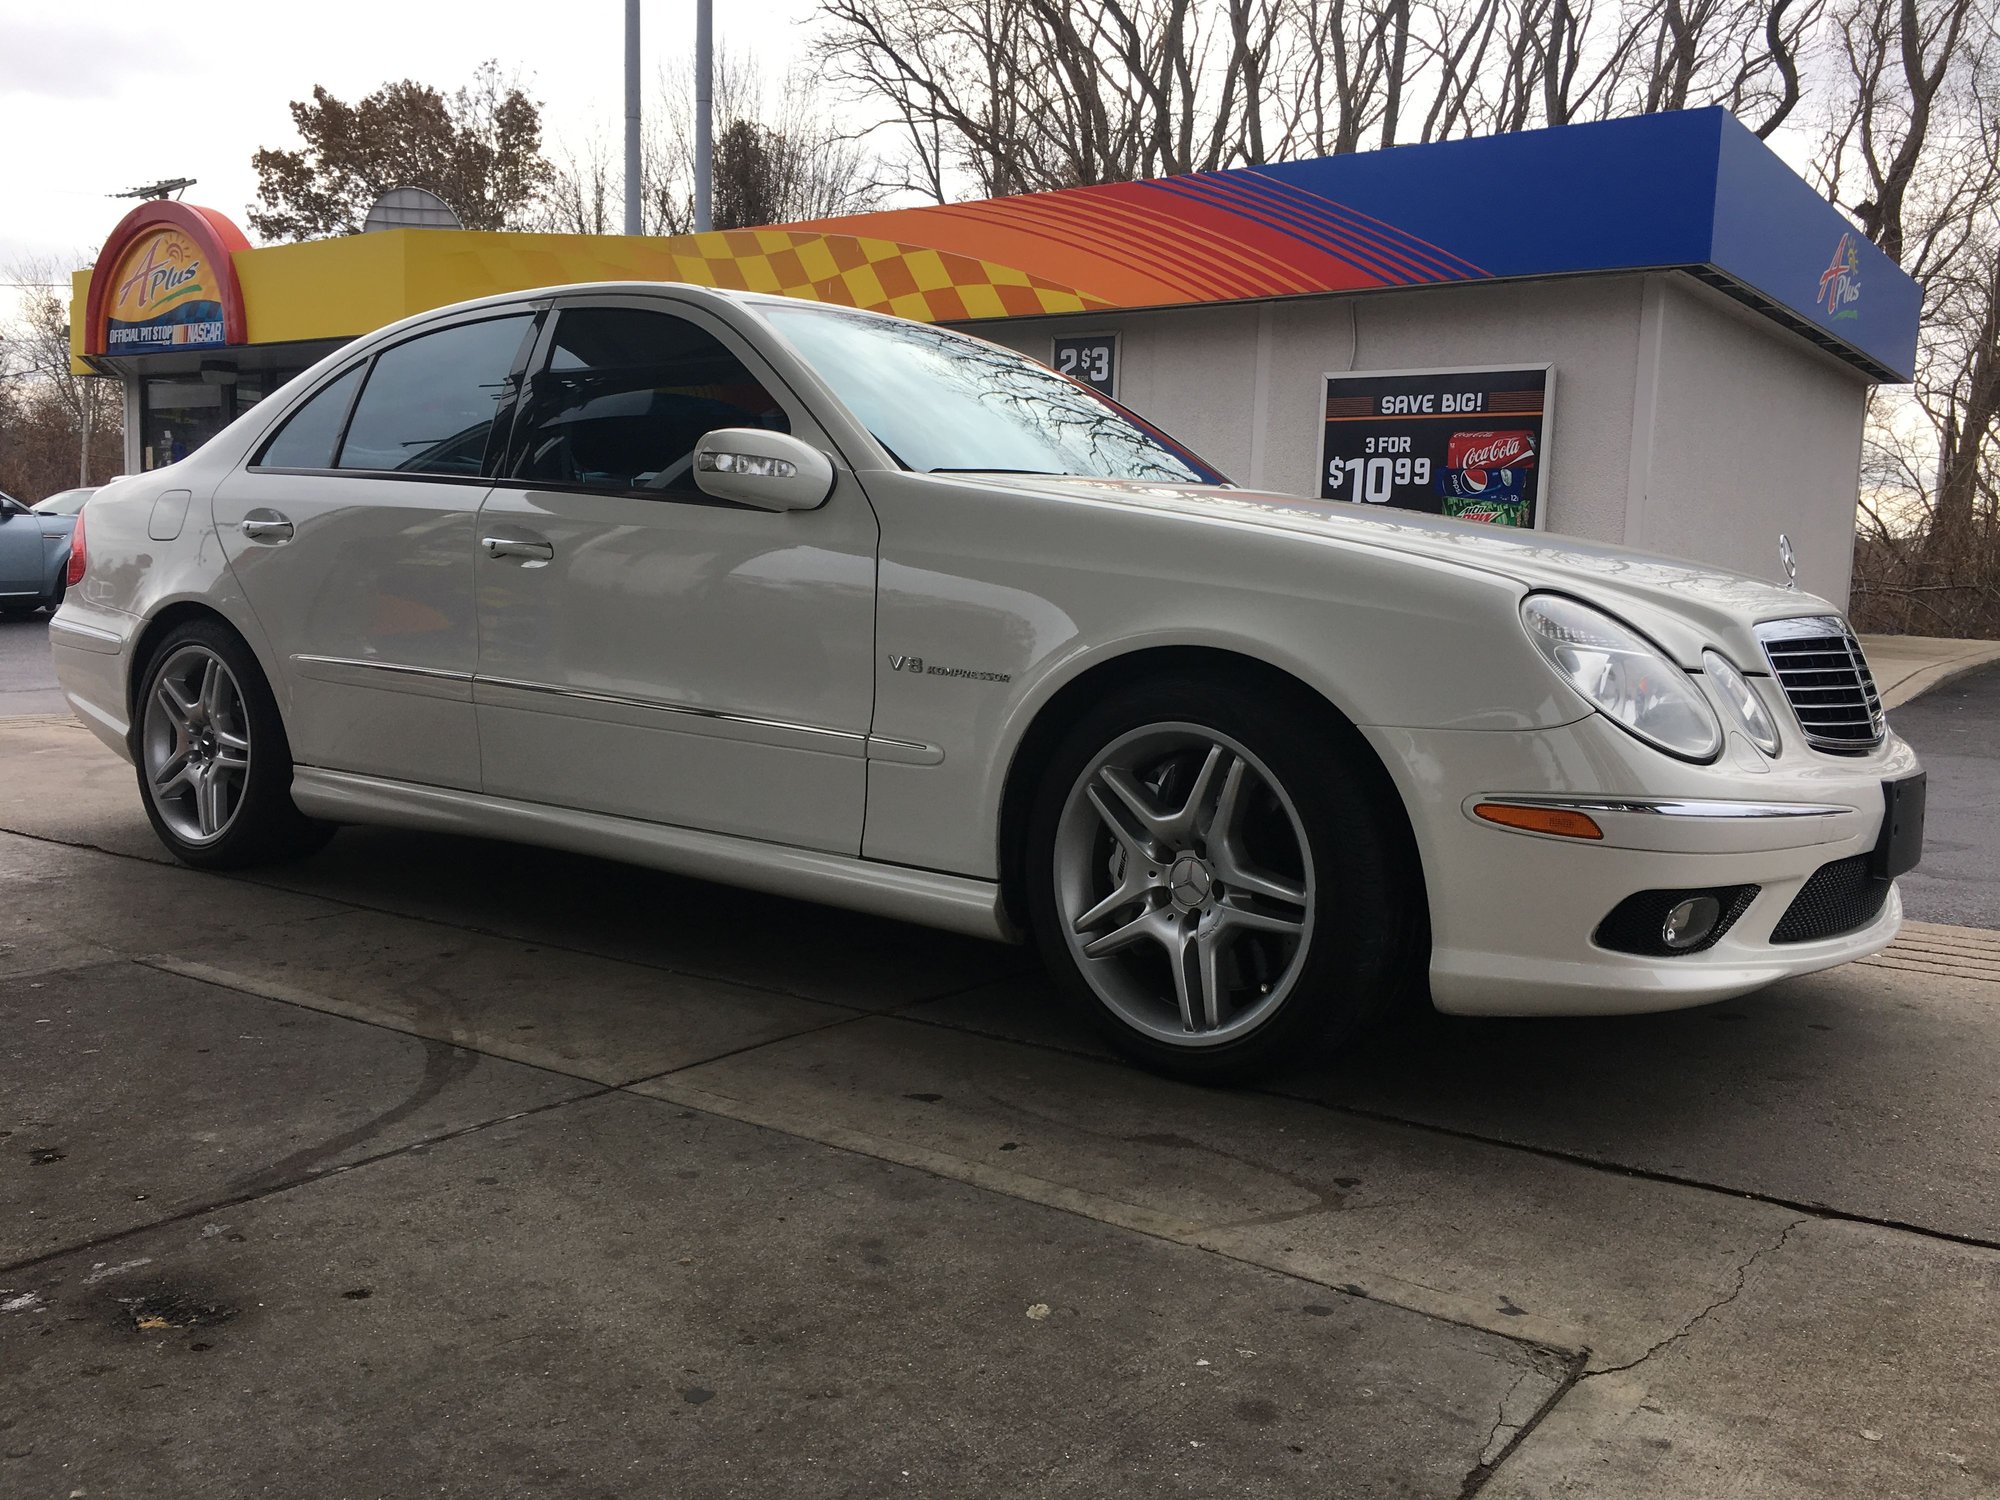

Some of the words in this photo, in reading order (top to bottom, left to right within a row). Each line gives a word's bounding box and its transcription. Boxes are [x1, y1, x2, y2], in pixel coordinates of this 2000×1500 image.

[109, 328, 140, 344] OFFICIAL
[140, 326, 153, 342] PIT
[152, 325, 172, 341] STOP
[187, 321, 223, 344] NASCAR
[1381, 394, 1435, 415] SAVE
[1441, 392, 1483, 413] BIG!
[1365, 437, 1375, 454] 3
[1378, 436, 1412, 454] FOR
[888, 655, 923, 673] V8
[926, 665, 1012, 683] KOMPRESSOR
